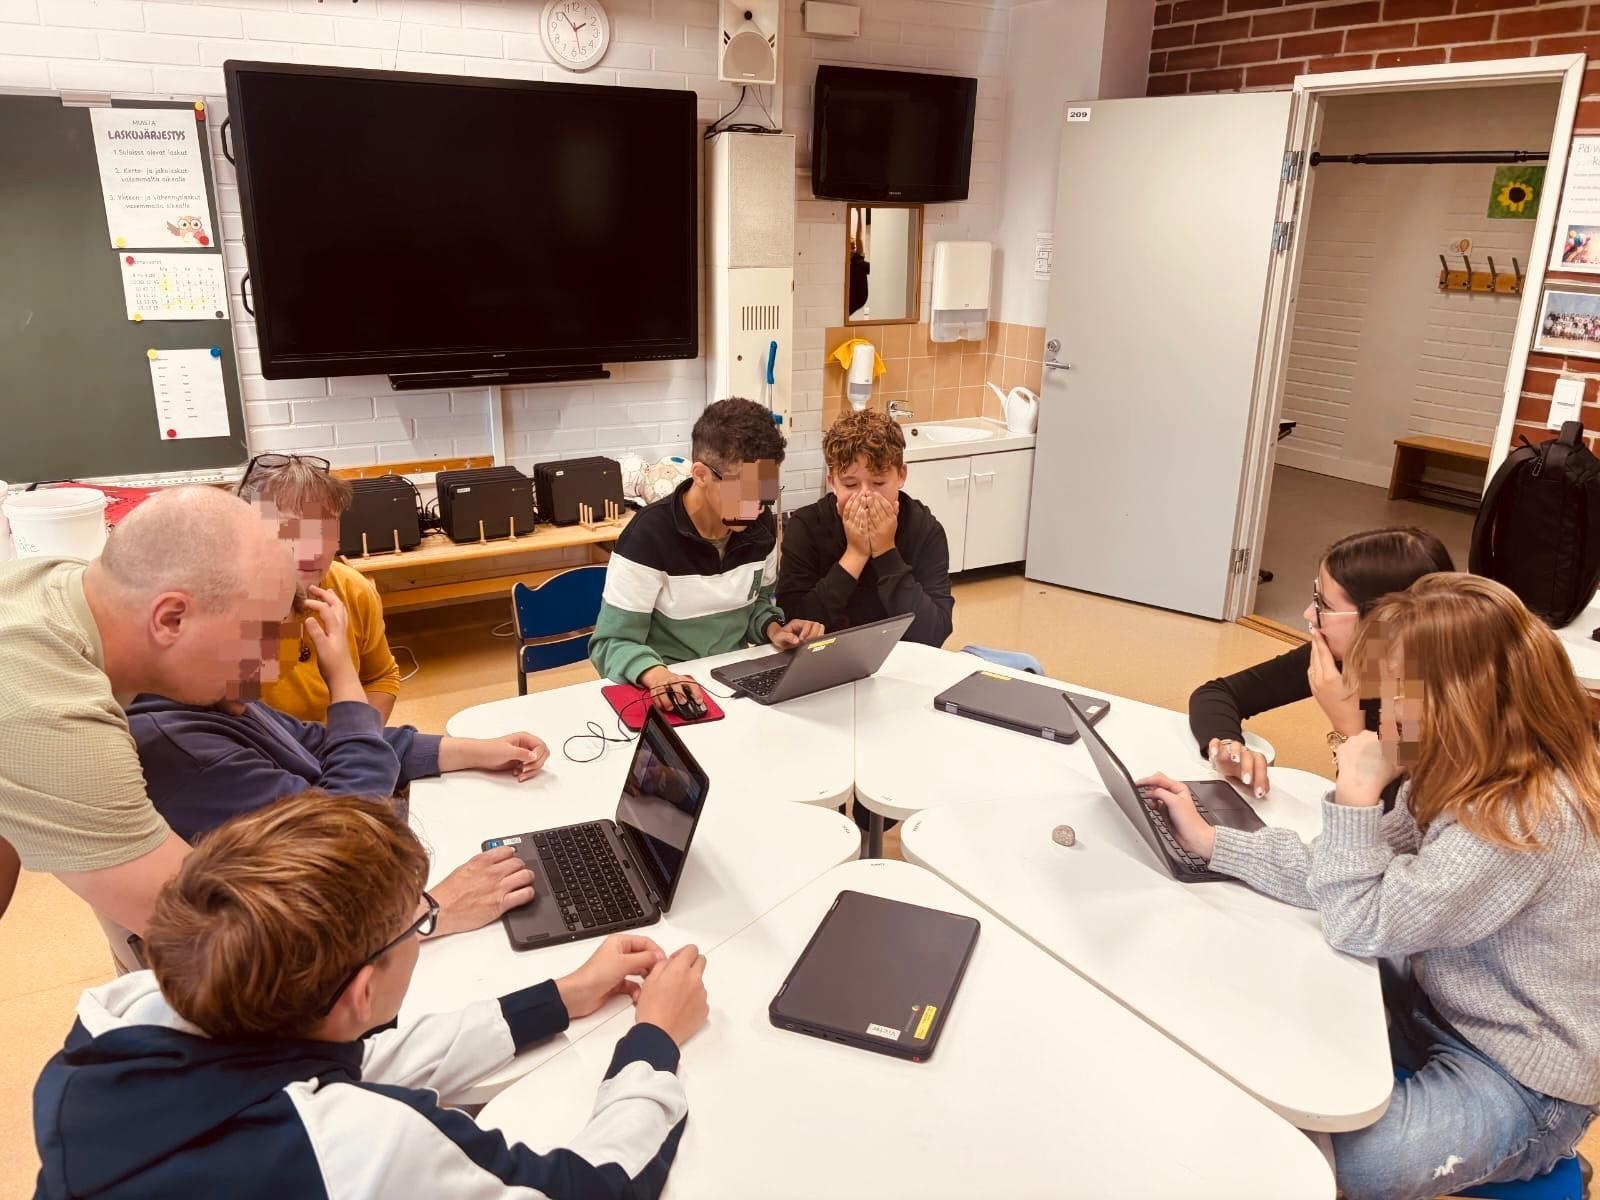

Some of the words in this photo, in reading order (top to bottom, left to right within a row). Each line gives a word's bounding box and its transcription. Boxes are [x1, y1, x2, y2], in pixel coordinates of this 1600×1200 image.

[564, 3, 570, 13] 11
[572, 2, 580, 12] 12
[590, 17, 597, 26] 2
[552, 22, 557, 32] 9
[592, 29, 598, 38] 3
[555, 34, 560, 43] 8
[588, 40, 594, 48] 4
[571, 47, 577, 57] 6
[581, 46, 587, 55] 5
[108, 128, 185, 140] LASKUJÄRJESTYS
